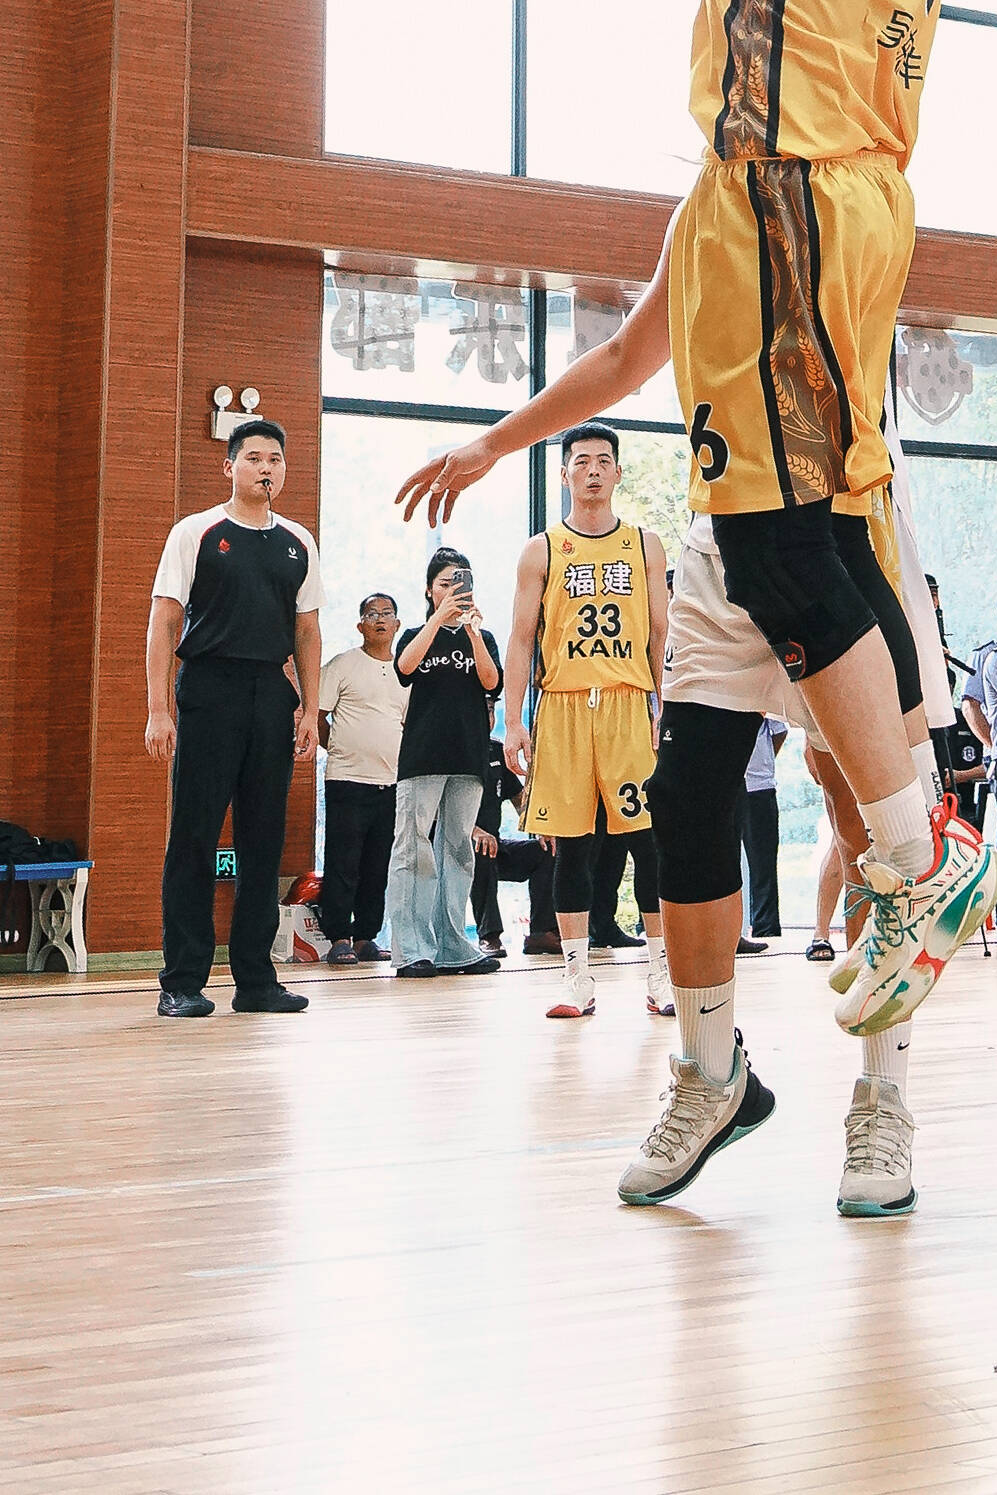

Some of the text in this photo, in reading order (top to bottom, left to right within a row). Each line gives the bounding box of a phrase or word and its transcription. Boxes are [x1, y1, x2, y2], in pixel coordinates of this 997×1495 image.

[690, 401, 730, 483] 6
[563, 560, 633, 599] 福建
[577, 602, 622, 639] 33
[567, 638, 633, 659] KAM
